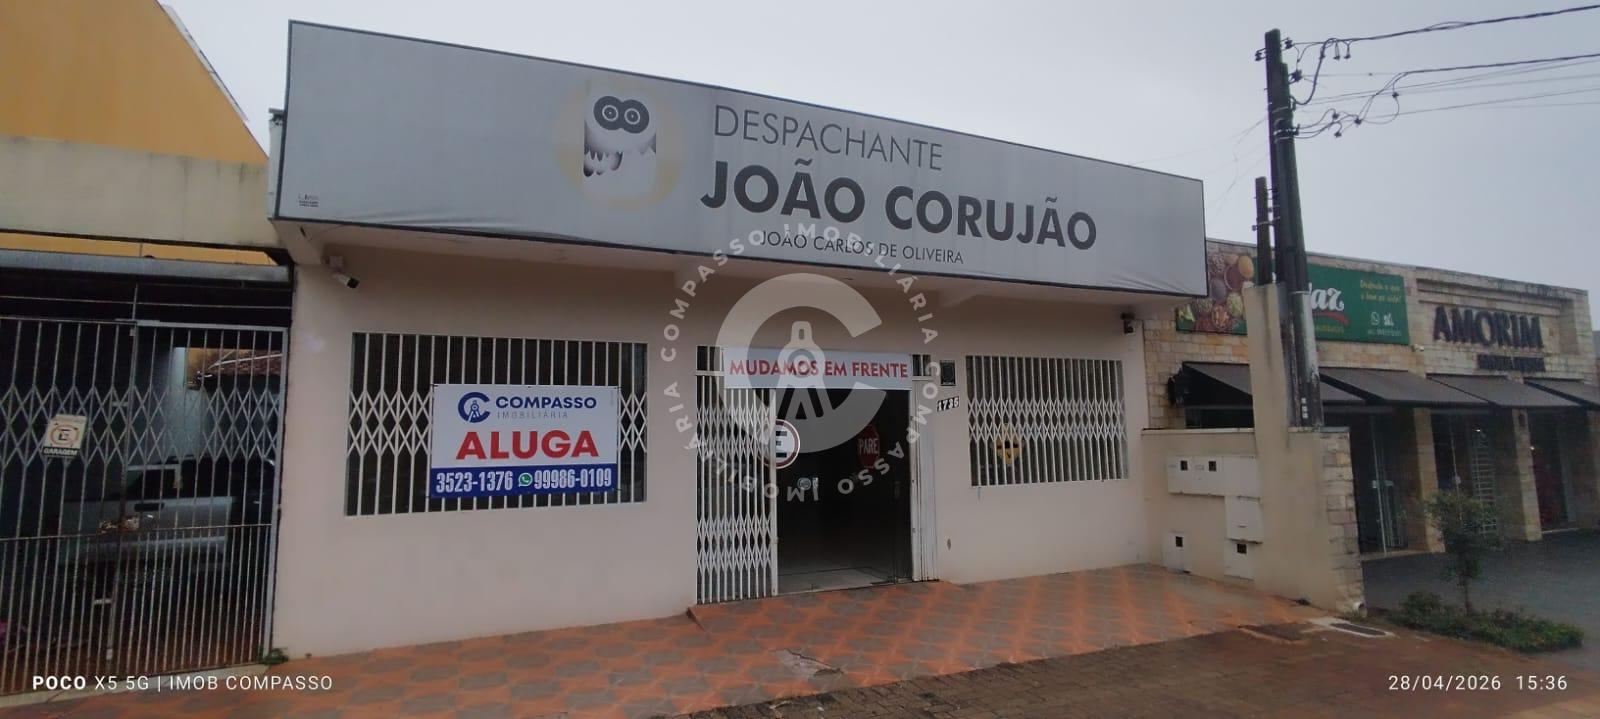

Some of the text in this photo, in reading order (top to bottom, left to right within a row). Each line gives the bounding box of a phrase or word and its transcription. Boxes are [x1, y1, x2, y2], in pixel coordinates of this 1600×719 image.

[714, 104, 943, 171] DESPACHANTE
[700, 158, 1098, 251] JOÃO CORUJÃO
[761, 228, 964, 265] JOÃO CARLOS DE OLIVEIRA
[1433, 305, 1545, 349] AMORIM
[729, 359, 908, 379] MUDAMOS EM FRENTE
[495, 396, 598, 410] COMPASSO
[497, 410, 569, 420] IMOBILIÁRIA
[43, 447, 78, 456] GARAGEM
[455, 429, 600, 461] ALUGA
[858, 438, 879, 455] PARE
[435, 467, 613, 494] 3523-1376 99986-0109
